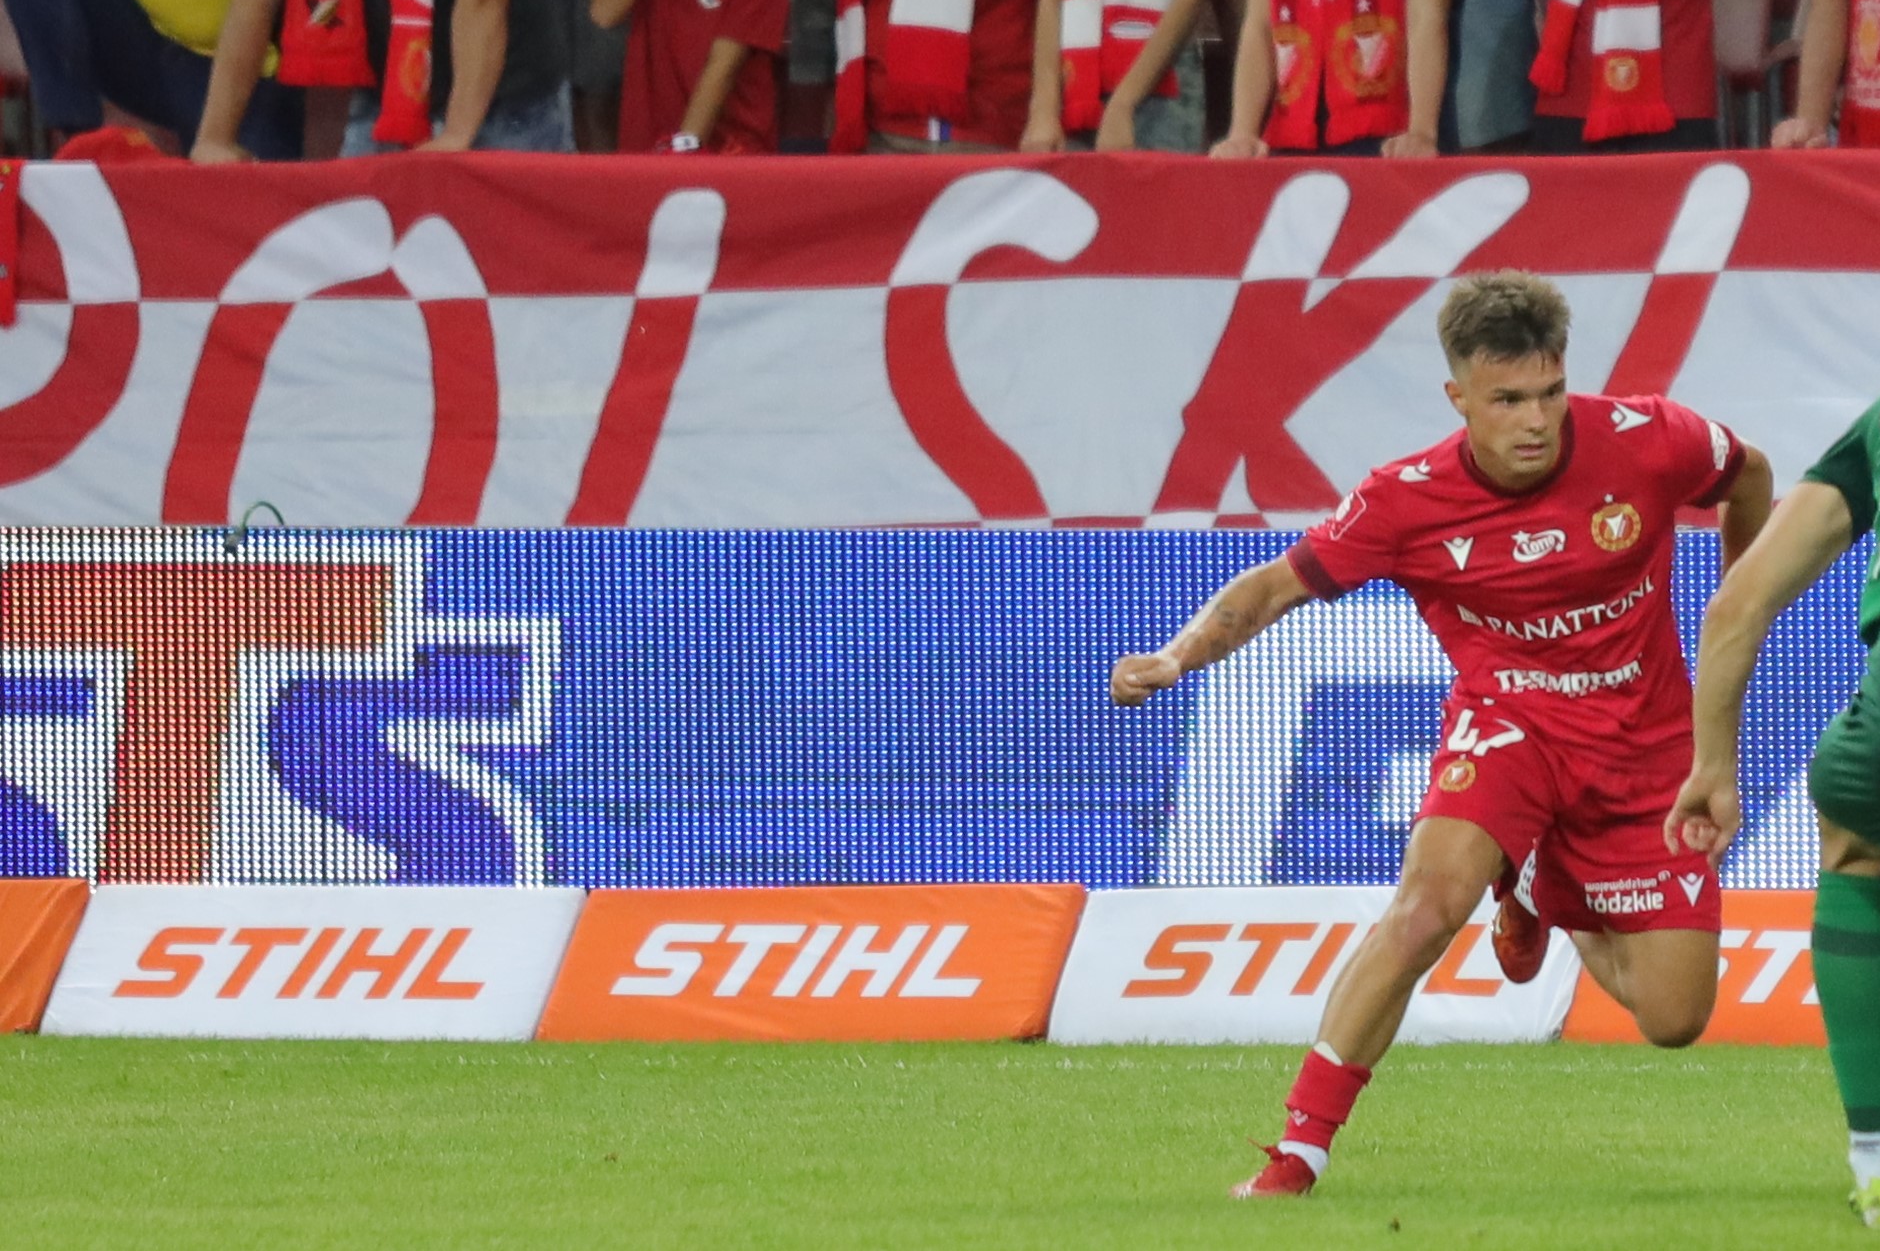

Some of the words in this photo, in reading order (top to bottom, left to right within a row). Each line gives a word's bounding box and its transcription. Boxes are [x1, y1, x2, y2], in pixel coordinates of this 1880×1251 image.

[1486, 575, 1655, 641] PANATTONI
[112, 926, 484, 1000] STIHL
[611, 922, 982, 998] STIHL
[1121, 923, 1506, 998] STIL
